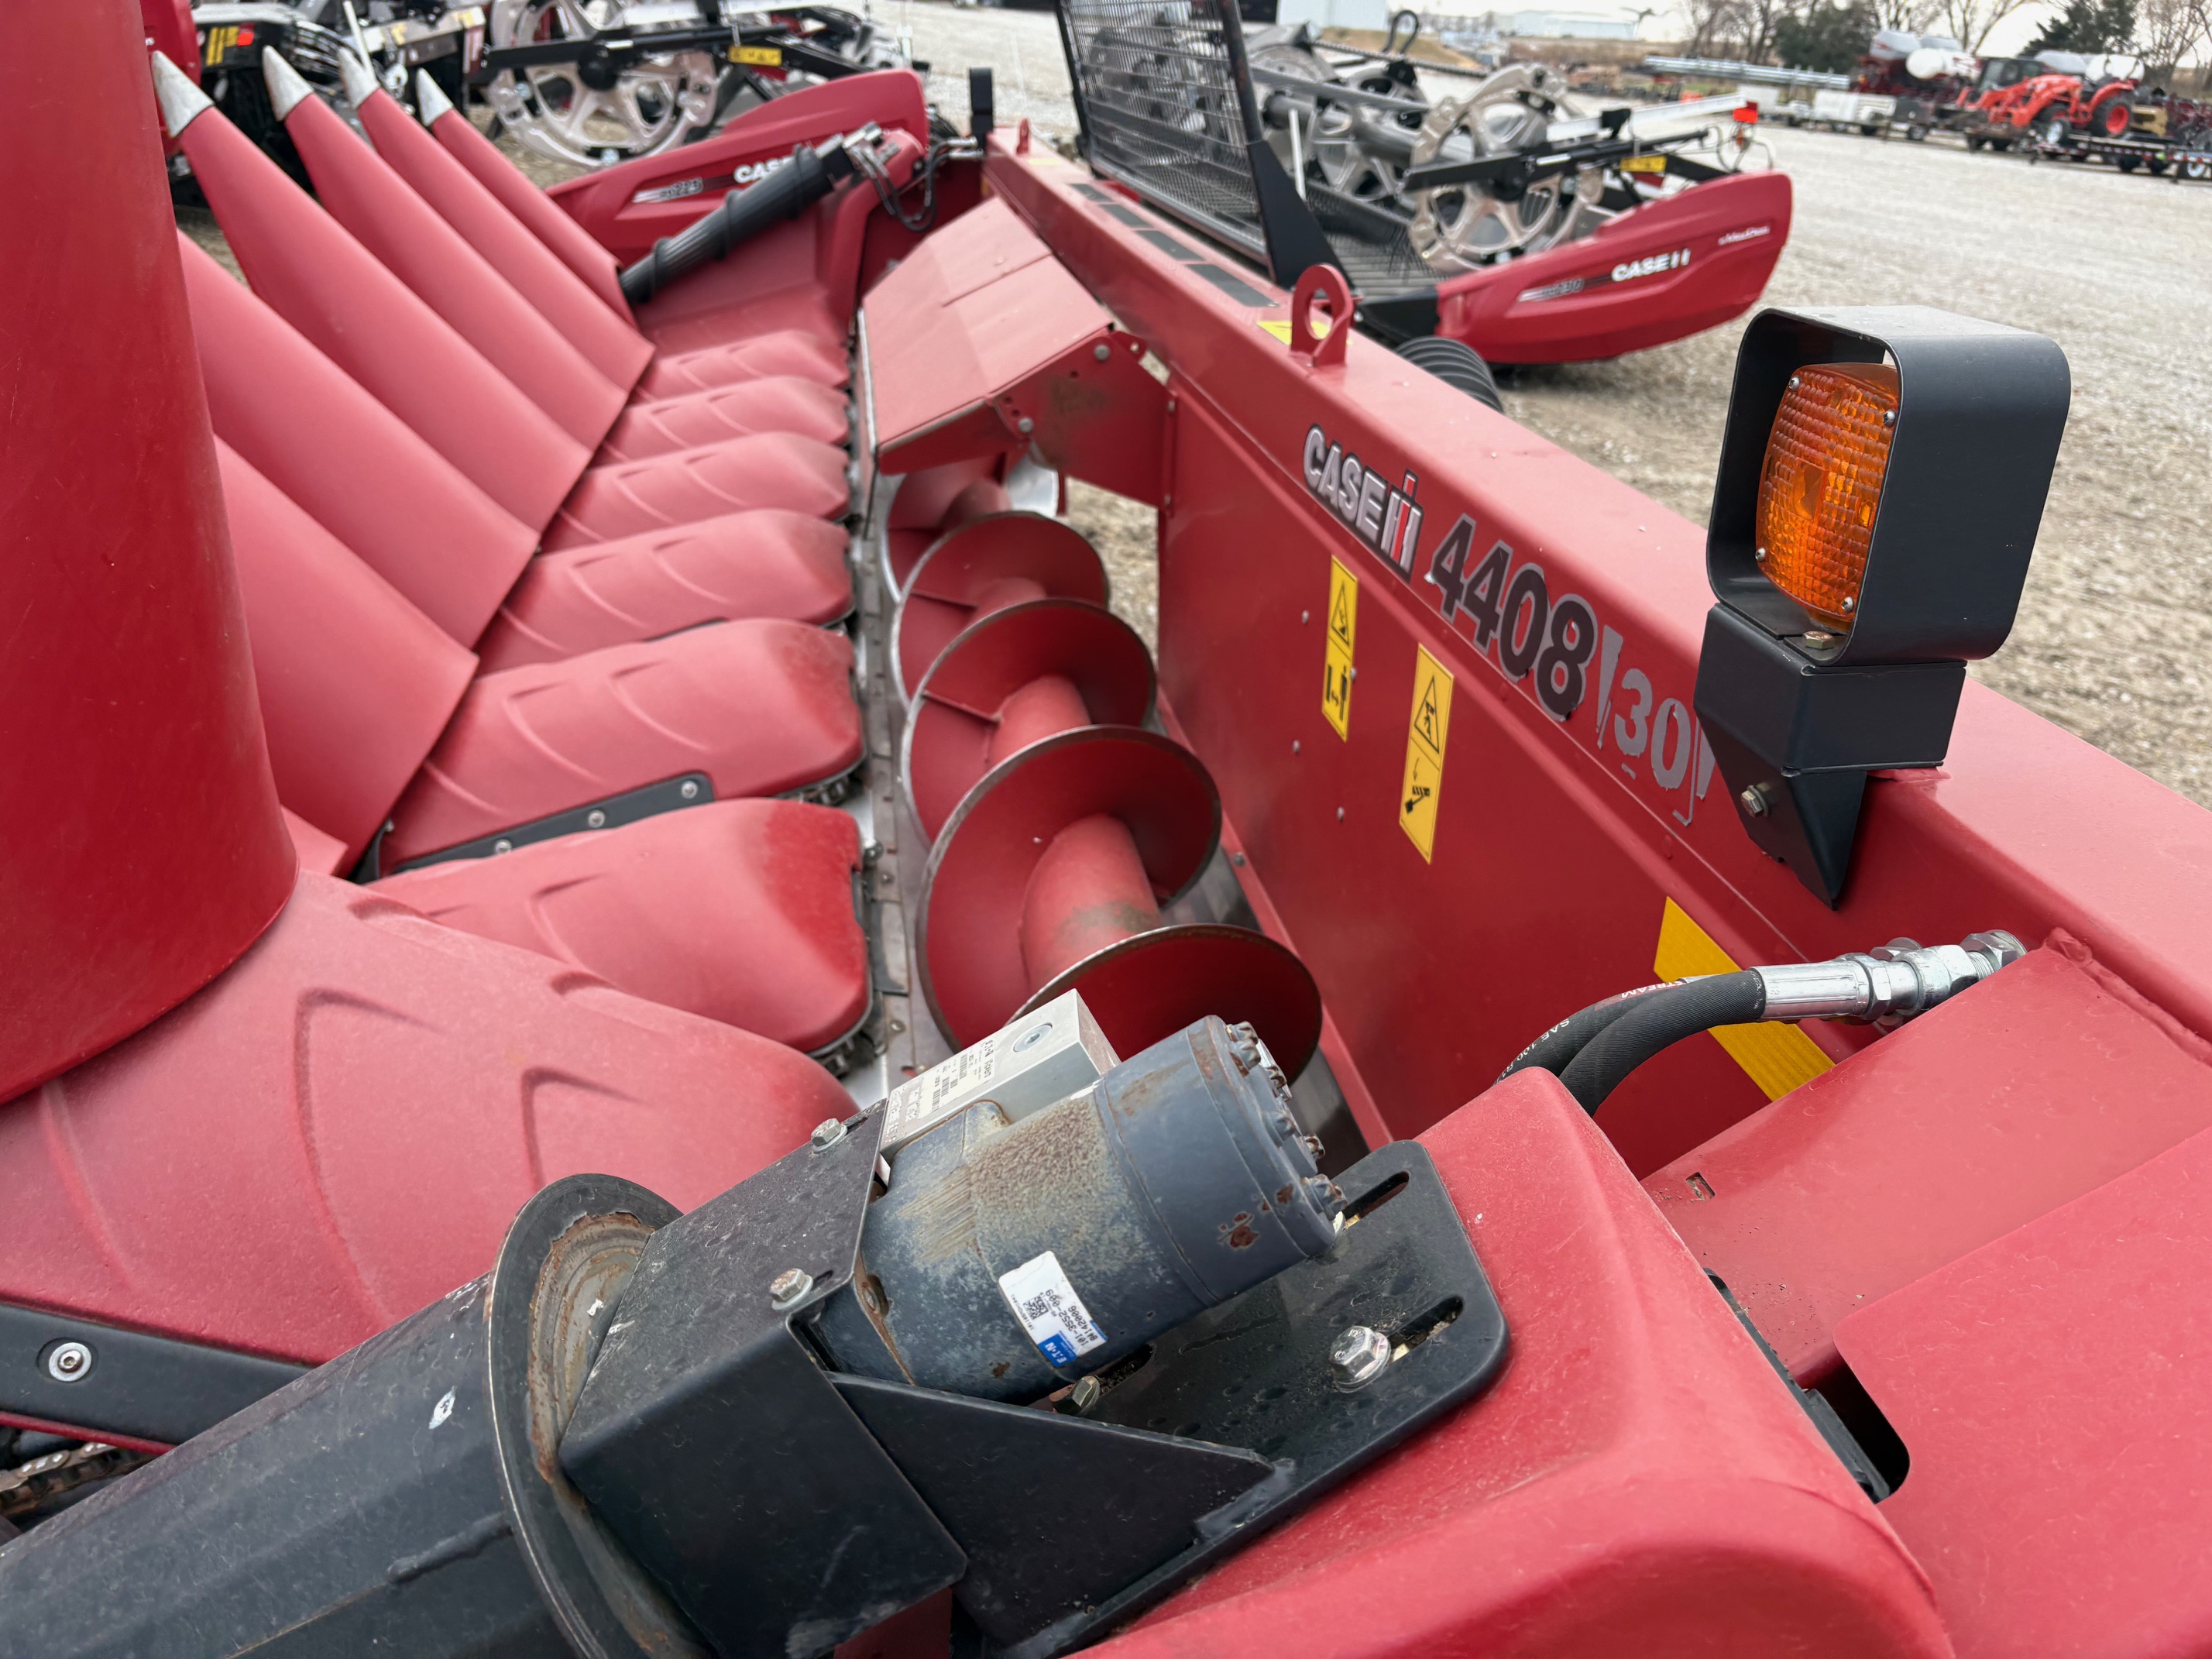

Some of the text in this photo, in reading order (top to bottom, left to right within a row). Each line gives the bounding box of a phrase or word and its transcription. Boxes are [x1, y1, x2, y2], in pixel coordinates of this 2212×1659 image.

[1612, 252, 1671, 282] CASE
[1303, 424, 1388, 542] CASE
[1430, 513, 1598, 723] 4408
[1614, 668, 1691, 790] 30
[1540, 1018, 1570, 1042] SAE
[1045, 1288, 1090, 1347] 101-3552-009
